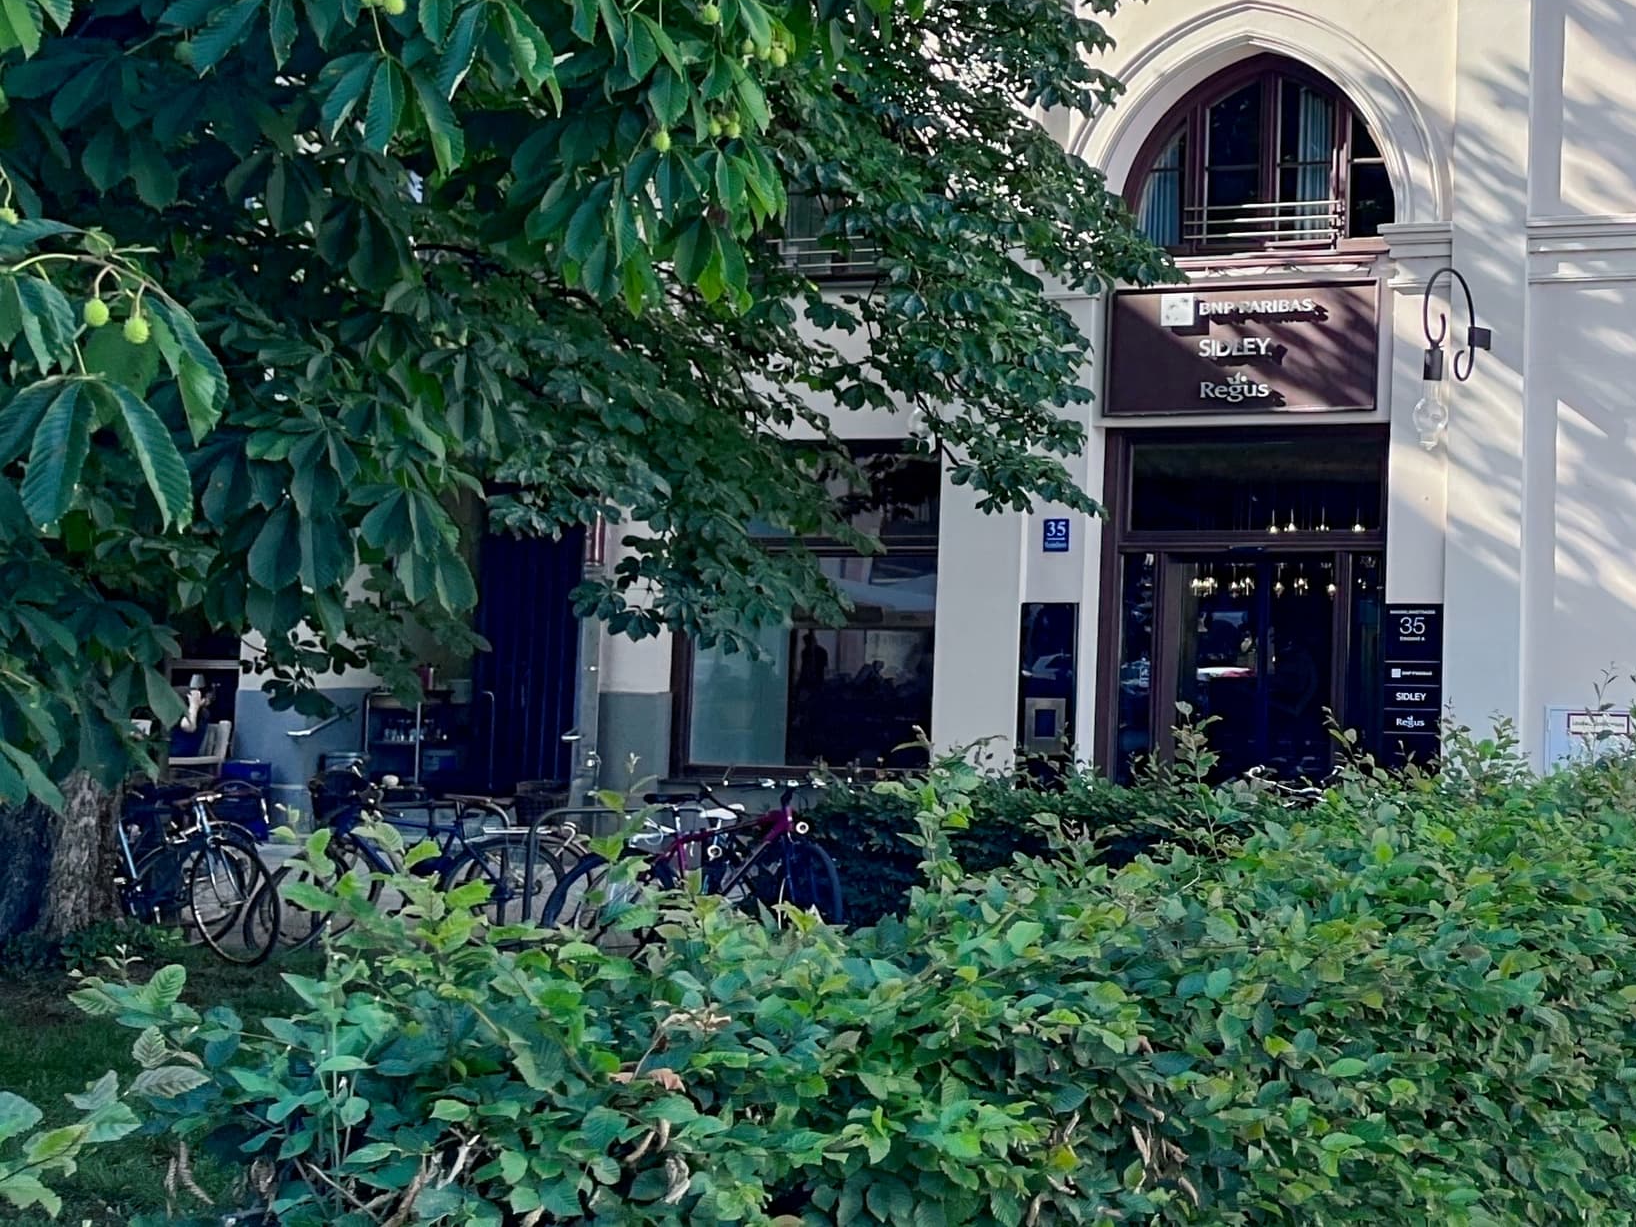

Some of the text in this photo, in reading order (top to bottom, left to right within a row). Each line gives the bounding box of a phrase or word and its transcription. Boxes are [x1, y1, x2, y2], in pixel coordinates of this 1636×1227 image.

[1199, 298, 1314, 315] BNP PARIBAS
[1199, 337, 1271, 357] SIDLEY
[1199, 375, 1270, 403] Regus
[1046, 521, 1067, 537] 35
[1399, 616, 1426, 635] 35
[1395, 692, 1427, 701] SIDLEY
[1396, 716, 1425, 728] Regus
